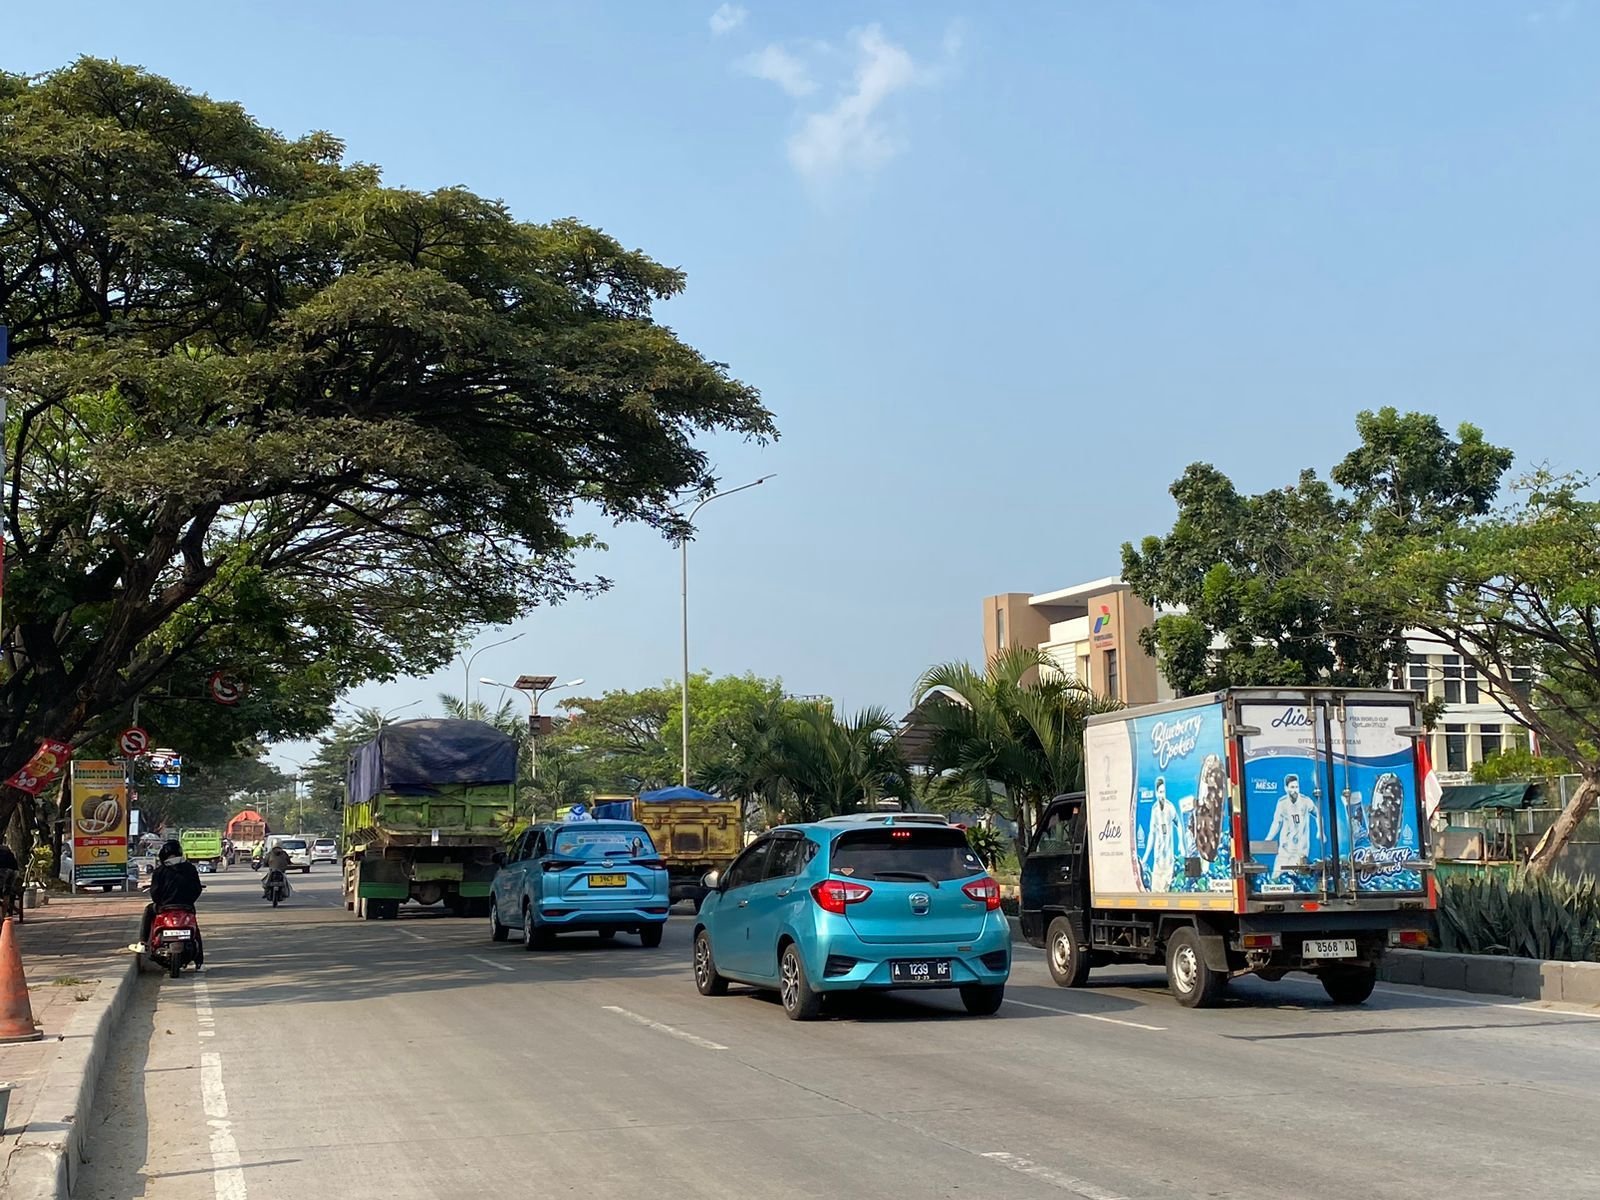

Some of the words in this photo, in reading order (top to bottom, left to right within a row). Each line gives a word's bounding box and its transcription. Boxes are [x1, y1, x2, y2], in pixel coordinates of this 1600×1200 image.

[1151, 714, 1203, 755] Blueberry
[1160, 737, 1196, 769] Cookies
[1255, 782, 1277, 790] MESSI
[1291, 814, 1300, 824] 10
[1098, 819, 1122, 841] Aice
[1360, 862, 1402, 882] Cokies
[1304, 942, 1310, 953] A
[1317, 941, 1338, 953] 8568
[1344, 941, 1355, 952] AJ
[894, 964, 901, 976] A
[909, 963, 929, 975] 1239
[937, 962, 948, 974] RF
